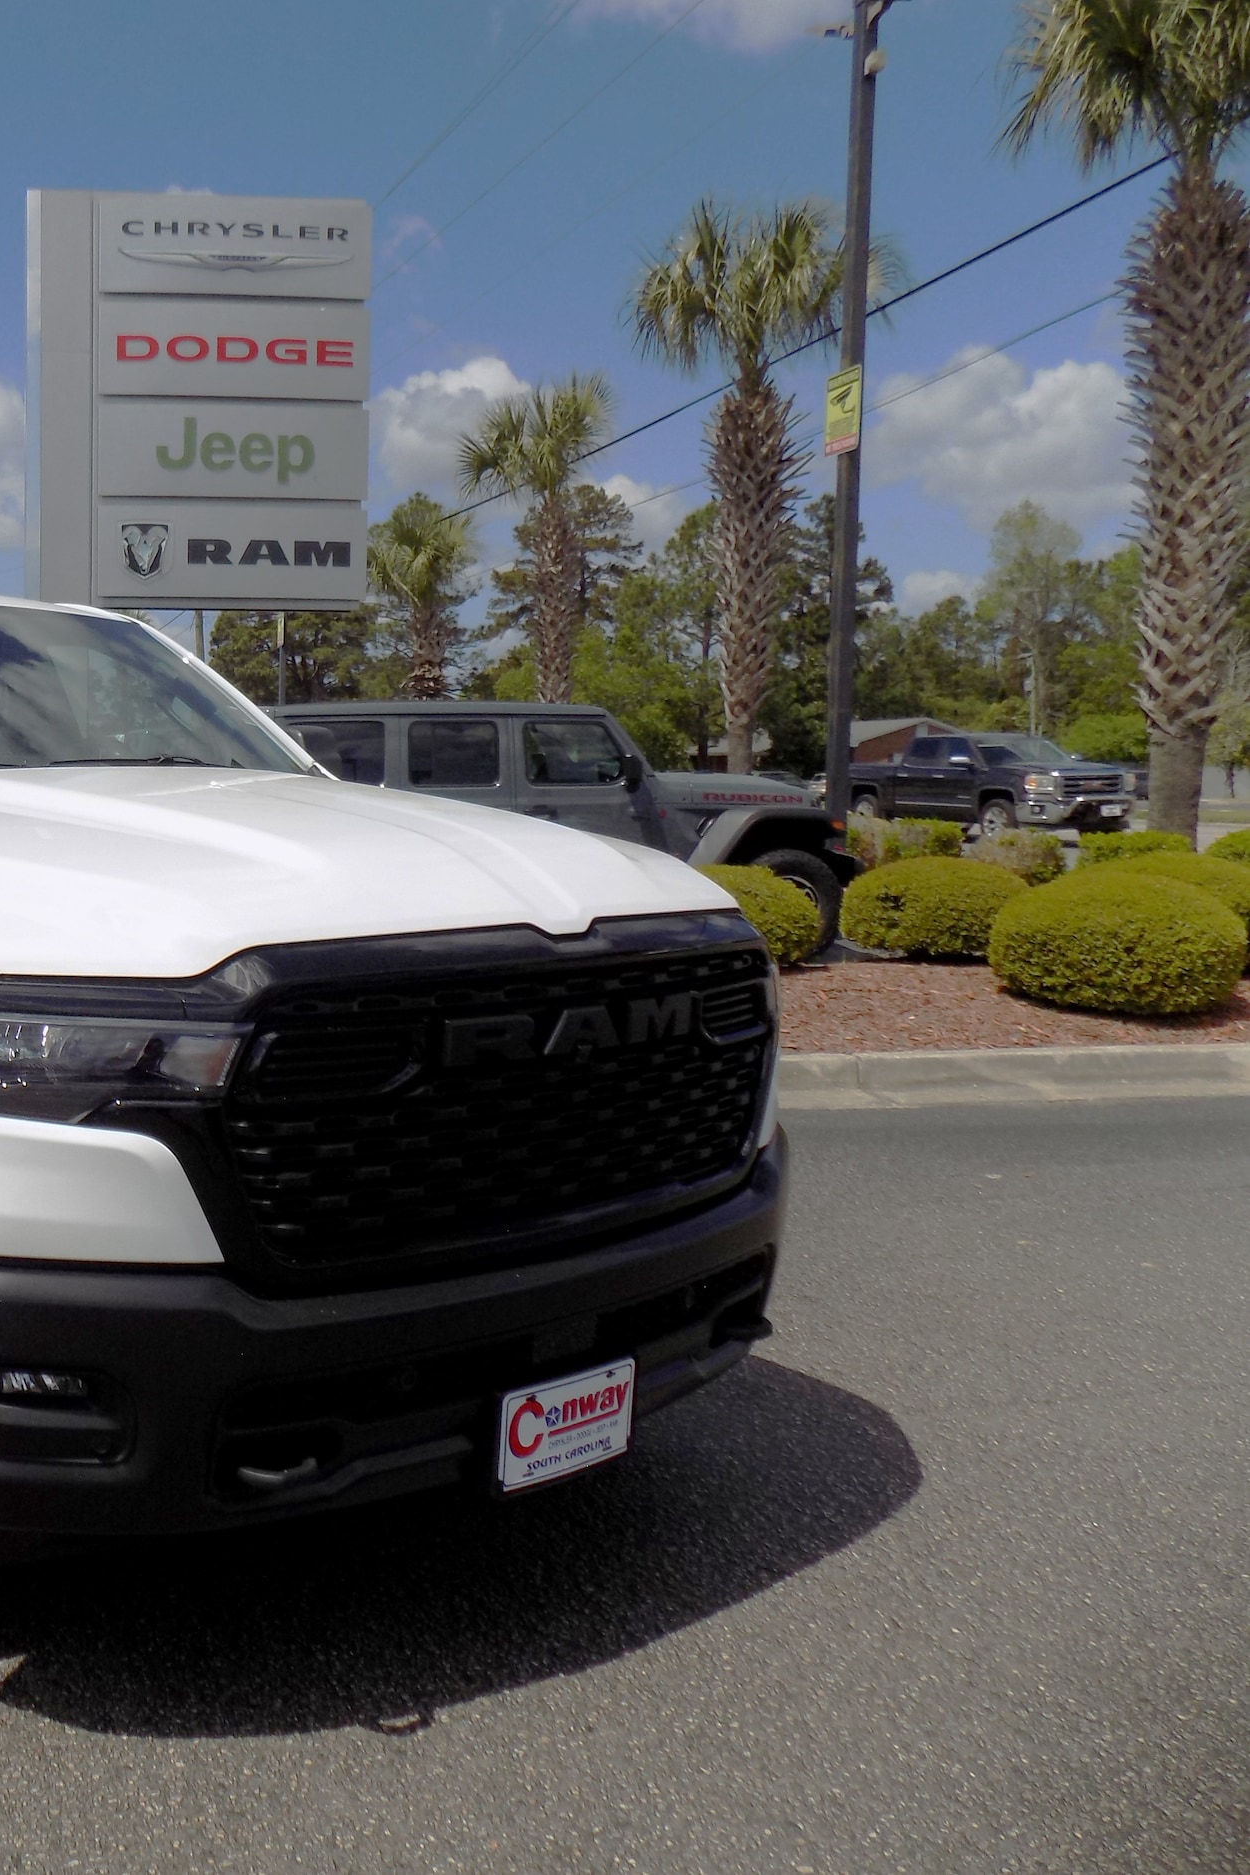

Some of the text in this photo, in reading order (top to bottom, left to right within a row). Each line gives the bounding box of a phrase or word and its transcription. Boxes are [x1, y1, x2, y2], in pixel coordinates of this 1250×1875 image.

[121, 220, 350, 242] CHRYSLER
[116, 335, 354, 367] DODGE
[156, 417, 315, 485] Jeep
[187, 538, 350, 567] RAM
[702, 792, 804, 803] RUBICON
[444, 991, 693, 1066] RAM
[527, 1436, 611, 1472] SOUTH CAROLINA
